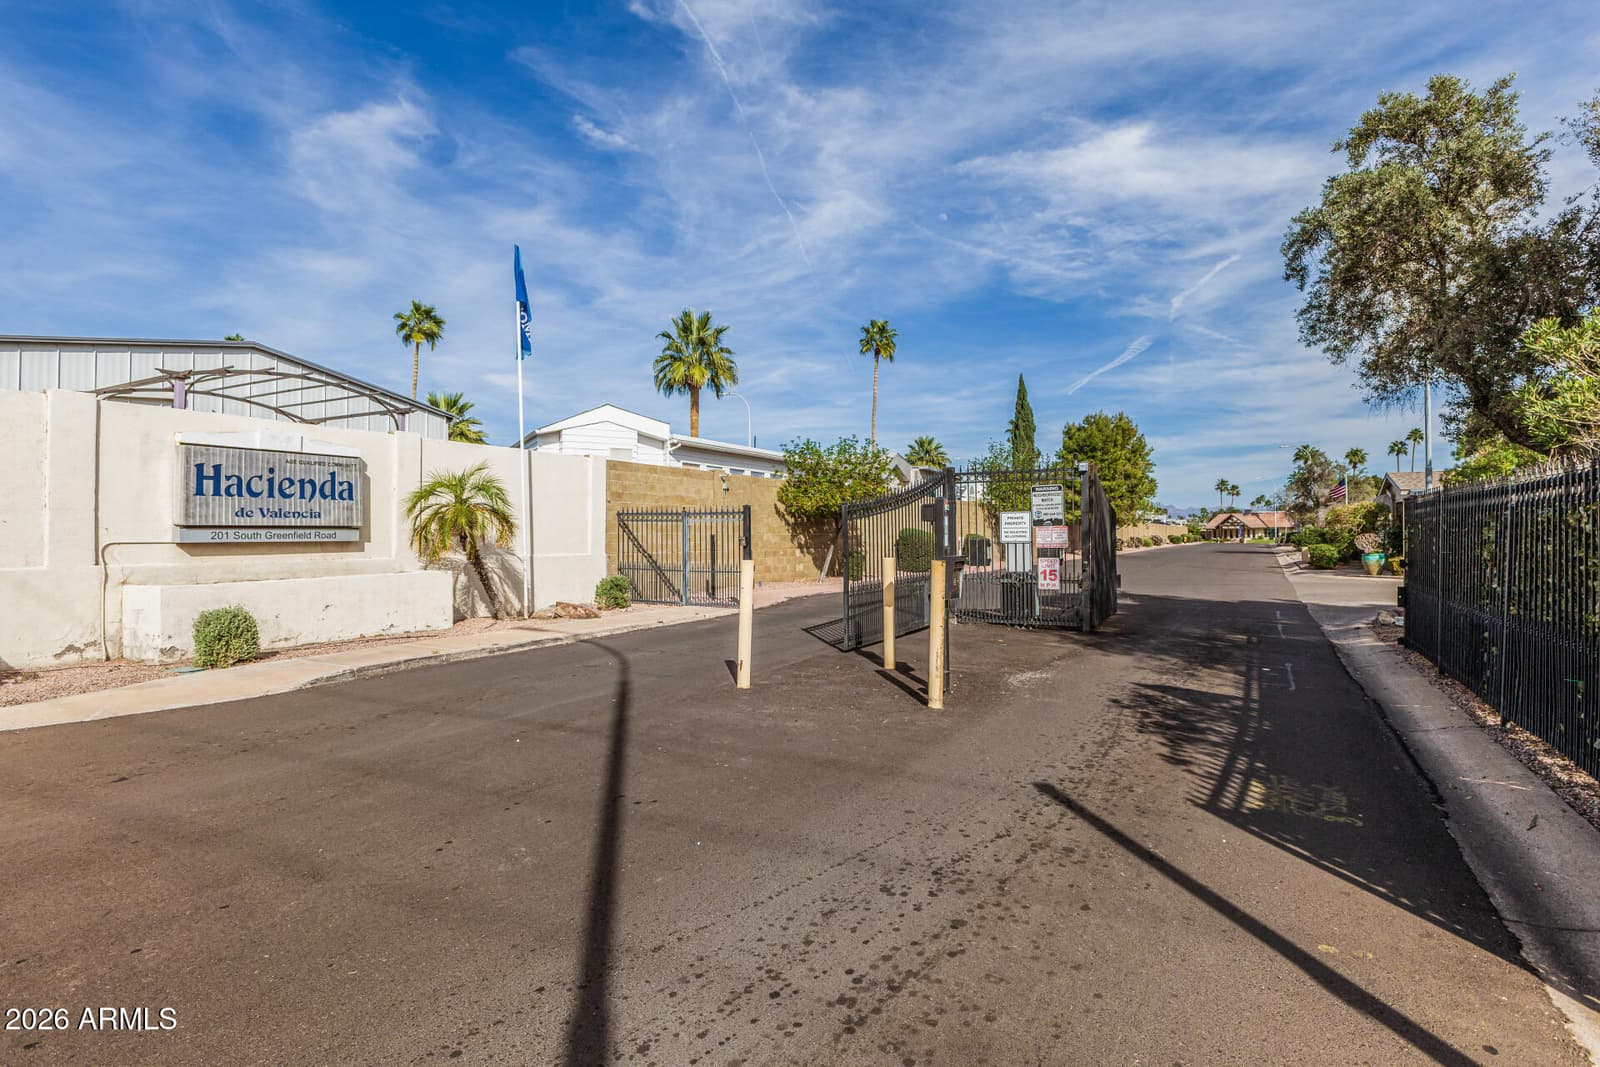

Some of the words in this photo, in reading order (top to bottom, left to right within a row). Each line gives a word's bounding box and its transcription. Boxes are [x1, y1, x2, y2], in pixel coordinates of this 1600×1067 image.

[194, 462, 354, 503] Hacienda
[235, 507, 254, 518] de
[258, 507, 321, 520] Valencia
[210, 531, 229, 540] 201
[233, 530, 262, 540] South
[265, 529, 311, 540] Greenfield
[314, 530, 337, 540] Road
[1040, 569, 1058, 582] 15
